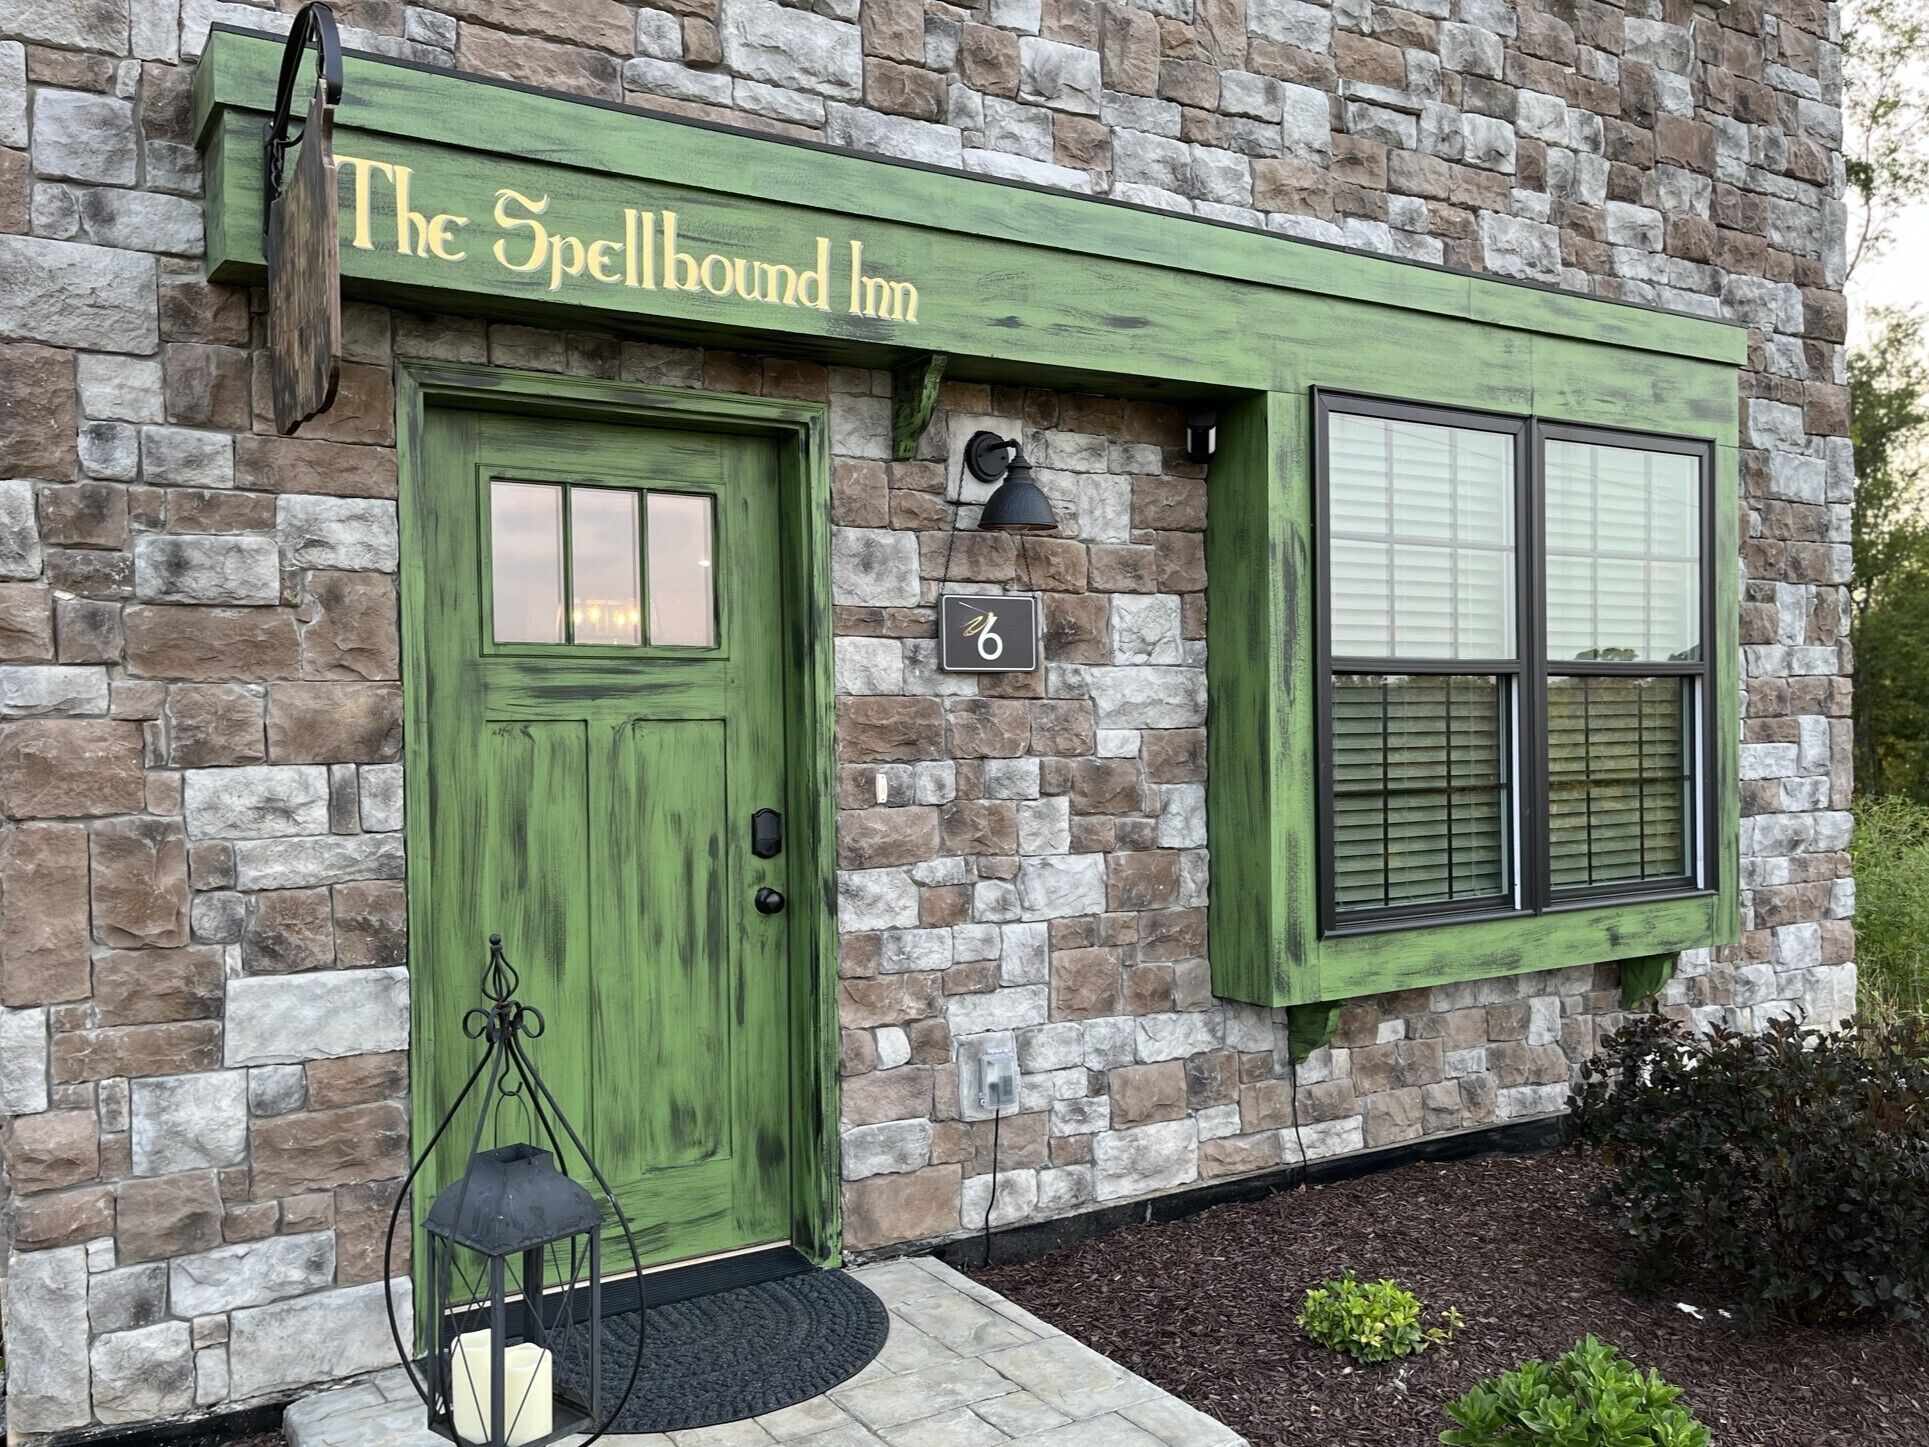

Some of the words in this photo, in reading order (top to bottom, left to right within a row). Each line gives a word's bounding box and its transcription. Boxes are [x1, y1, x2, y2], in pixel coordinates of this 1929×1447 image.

[333, 154, 468, 261] The
[494, 189, 830, 312] Spellbound
[850, 240, 918, 324] Inn
[977, 614, 1003, 660] 6
